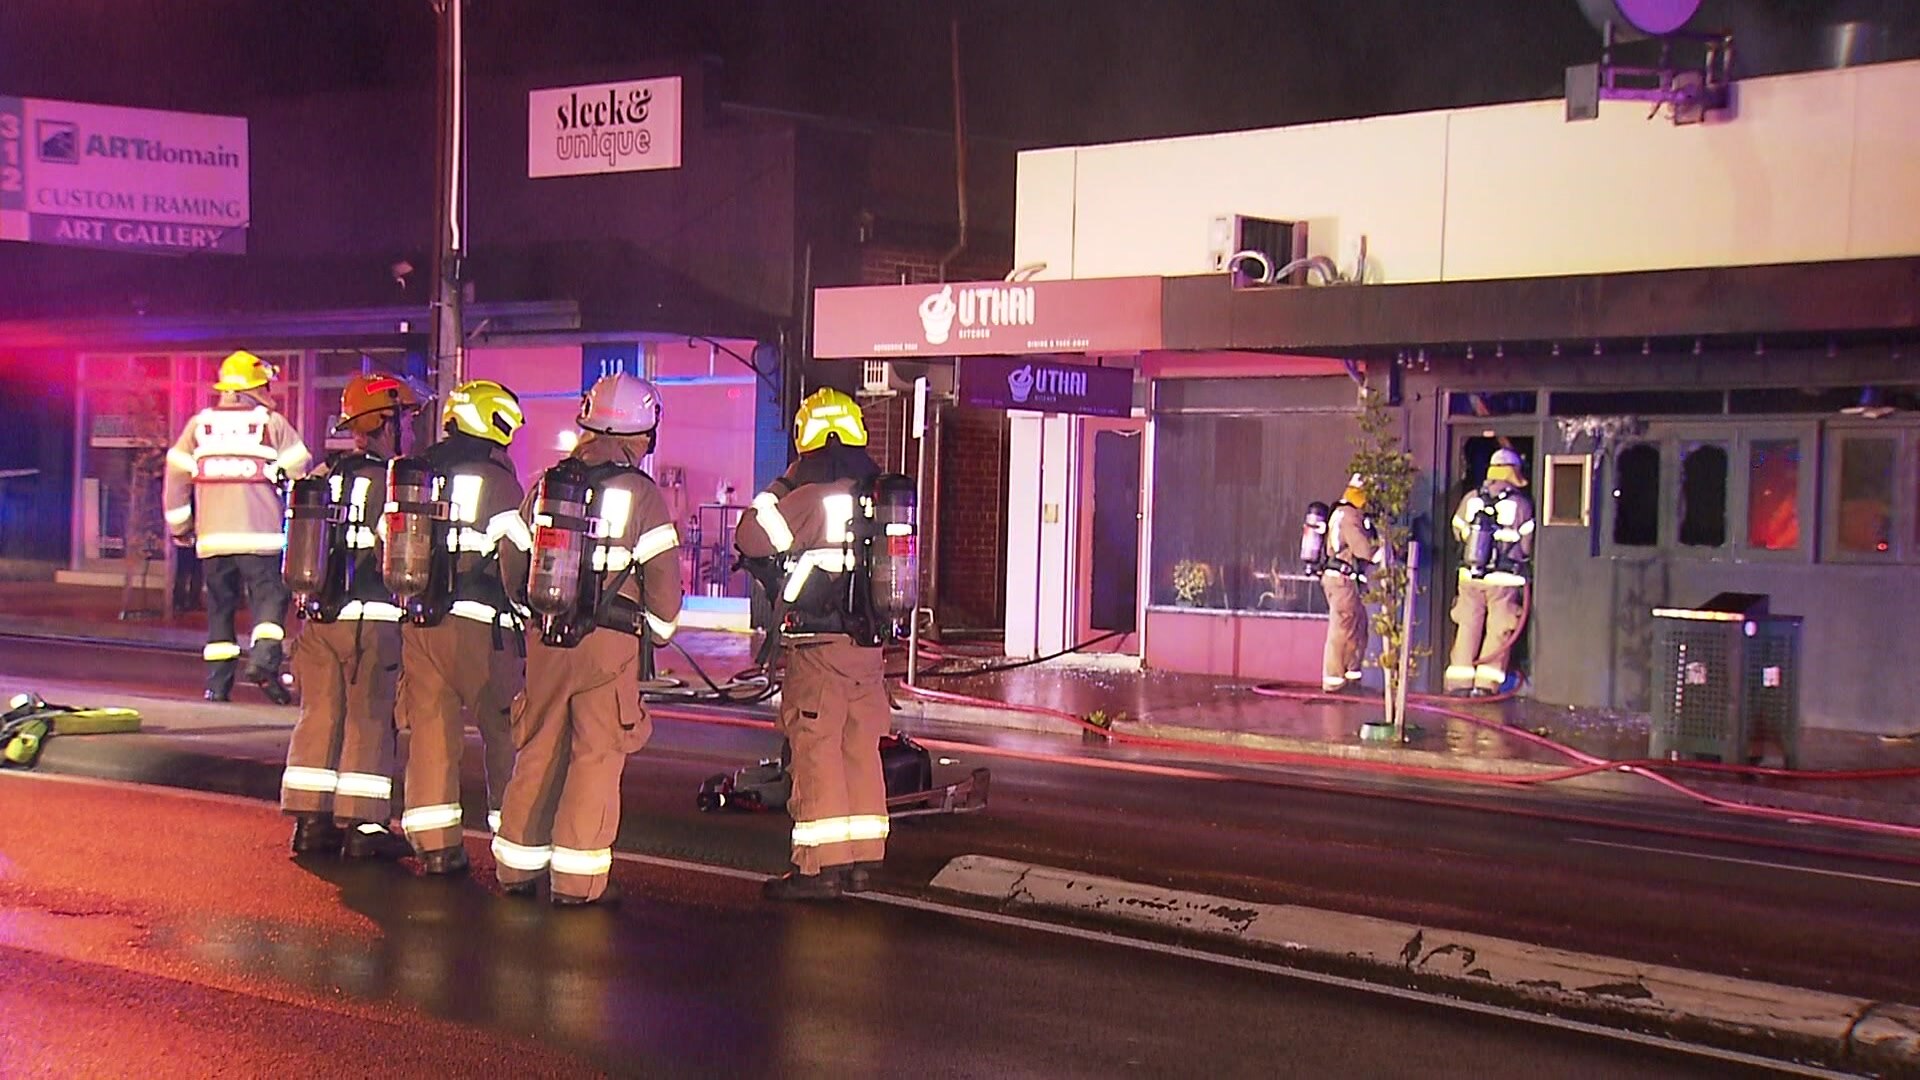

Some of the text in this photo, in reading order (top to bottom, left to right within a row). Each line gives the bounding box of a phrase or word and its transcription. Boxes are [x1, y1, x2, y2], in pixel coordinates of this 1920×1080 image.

[86, 133, 239, 168] ARTdomain
[557, 127, 651, 166] unique
[37, 187, 241, 218] CUSTOM FRAMING
[56, 220, 223, 248] ART GALLERY
[959, 286, 1035, 327] UTHAI
[1036, 368, 1088, 397] UTHAI
